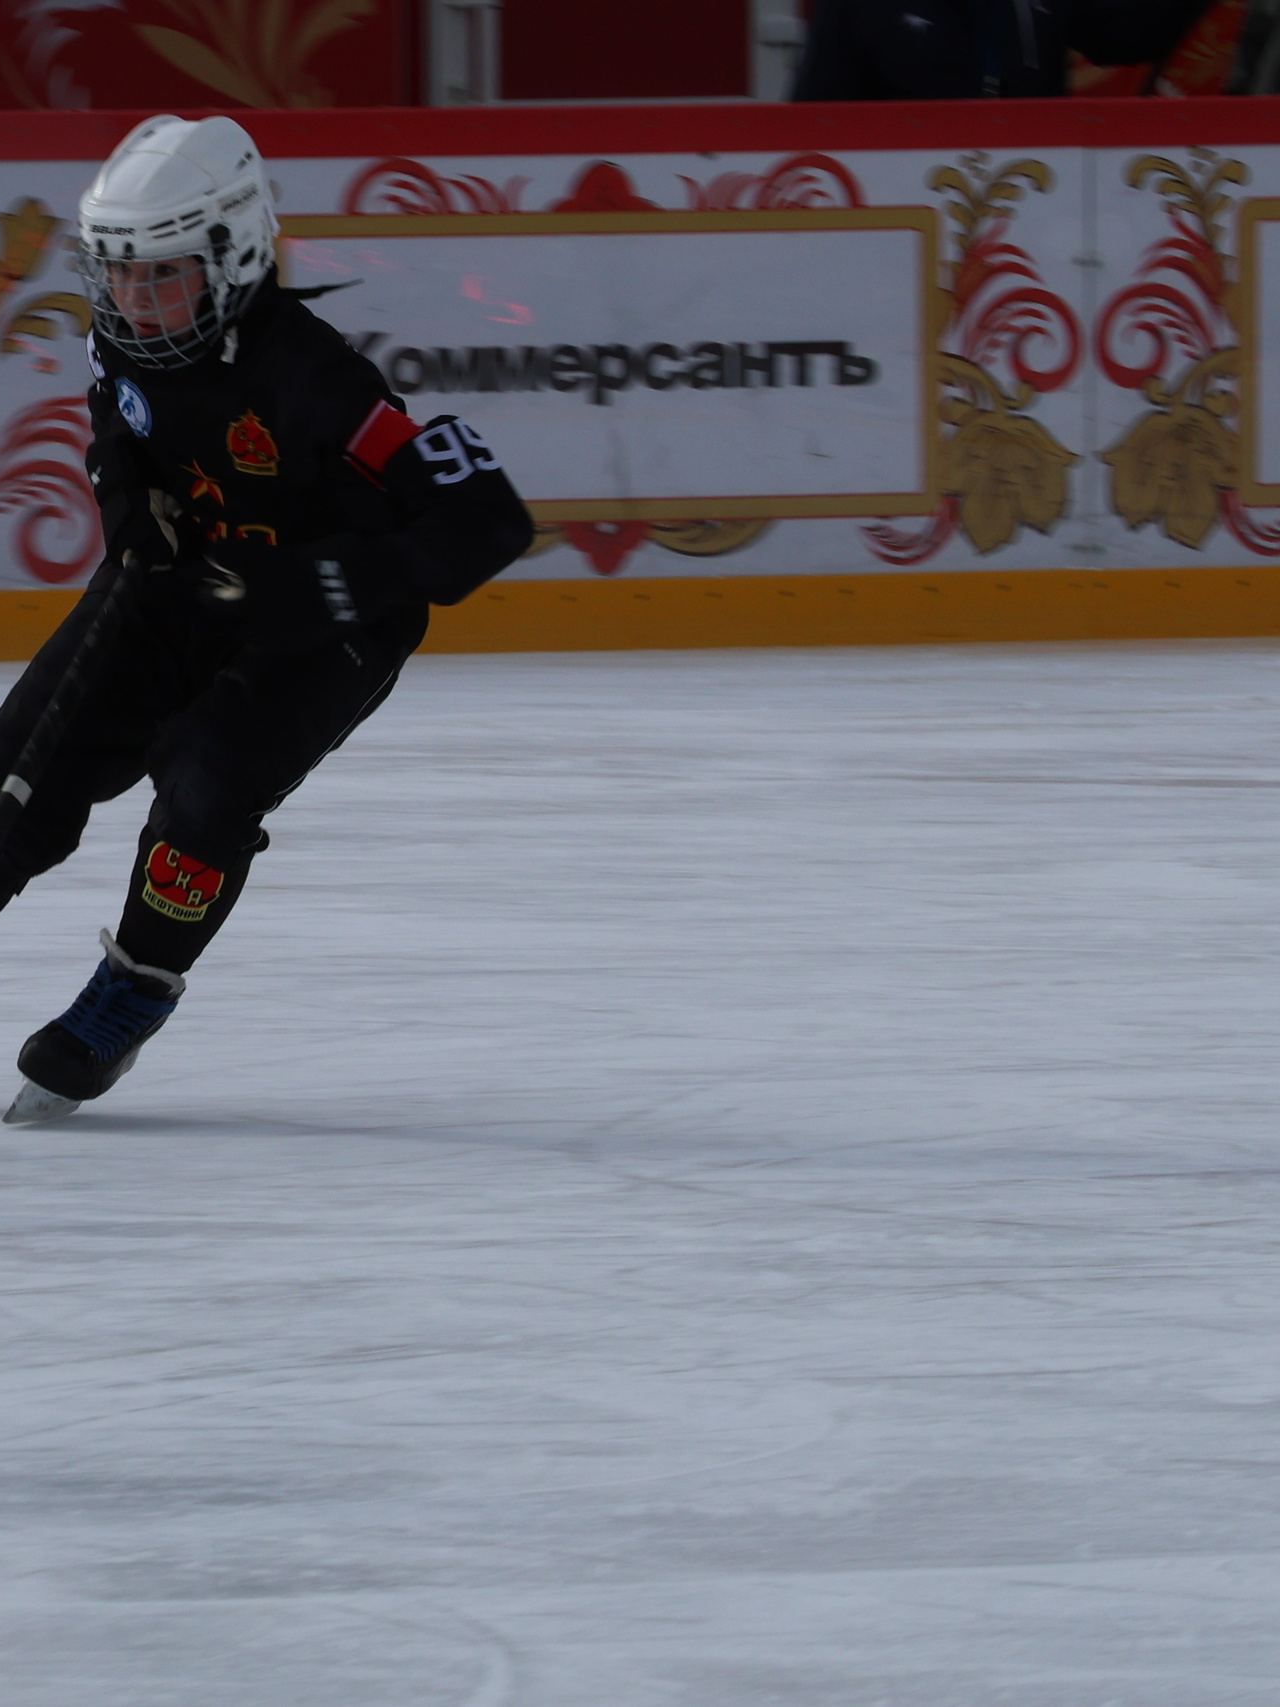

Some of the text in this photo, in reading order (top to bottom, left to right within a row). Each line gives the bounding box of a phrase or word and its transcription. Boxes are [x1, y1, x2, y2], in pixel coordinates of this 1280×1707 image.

[90, 223, 136, 237] BAUER
[165, 847, 203, 906] СКА
[144, 889, 204, 919] НЕФТЯНИК
